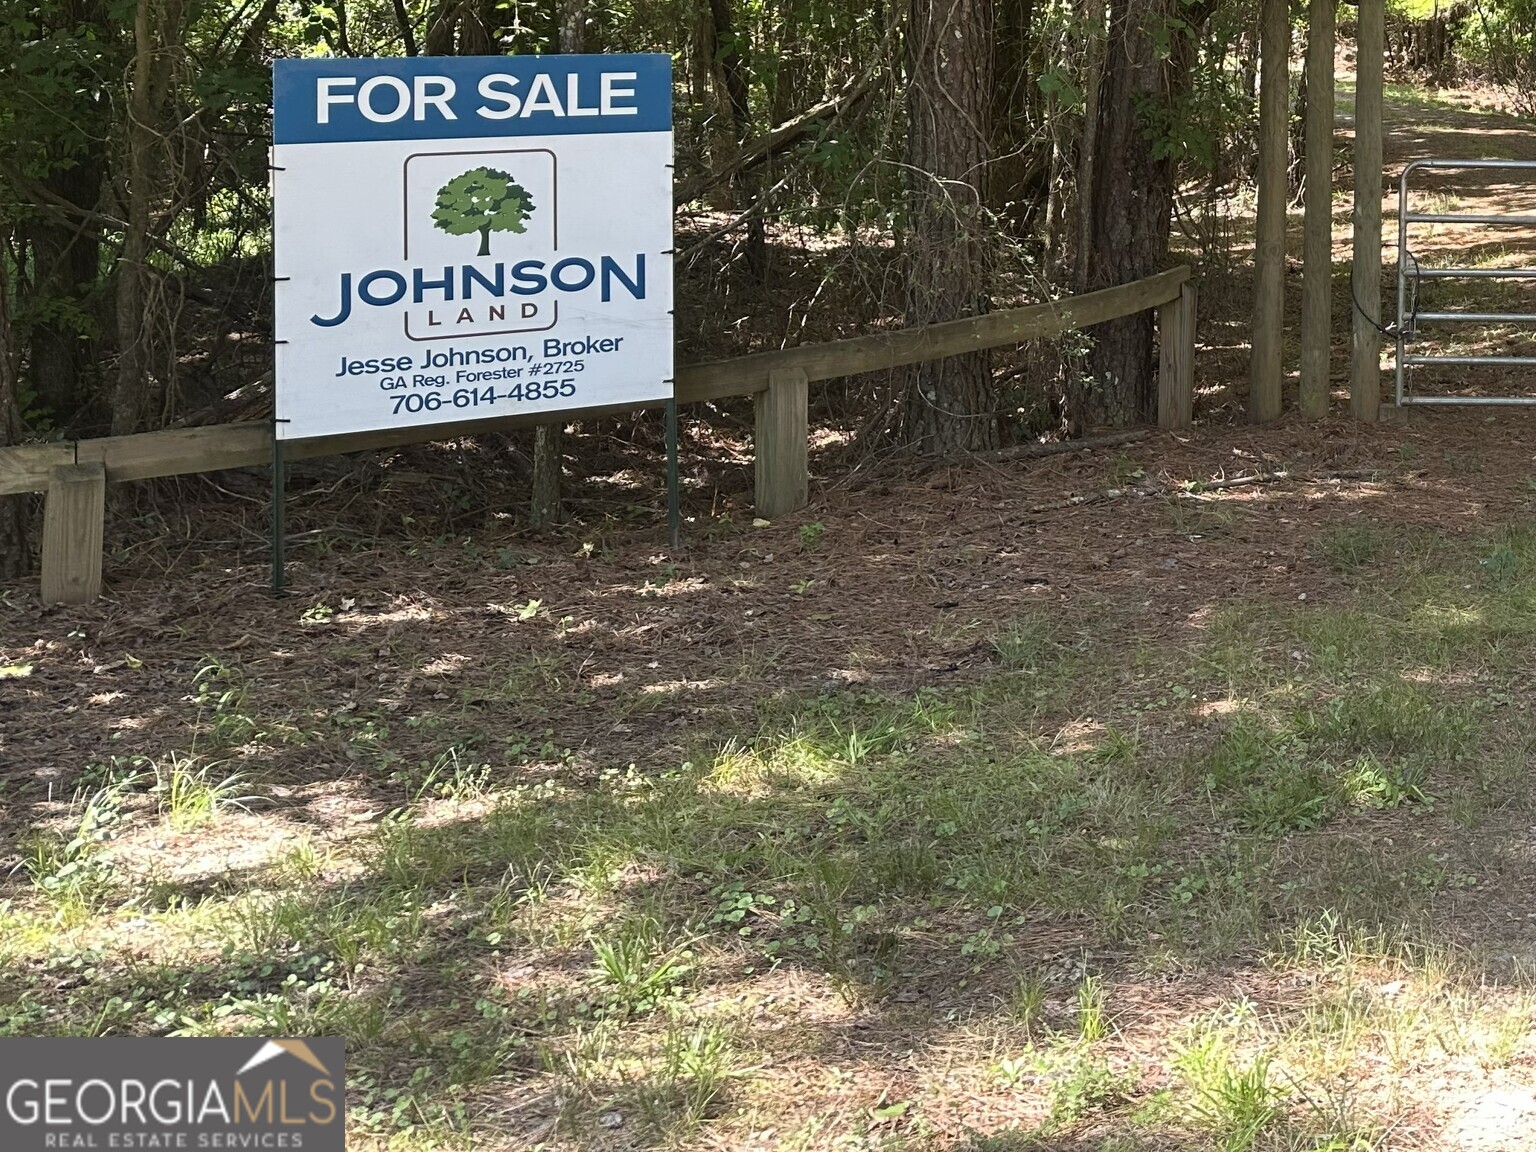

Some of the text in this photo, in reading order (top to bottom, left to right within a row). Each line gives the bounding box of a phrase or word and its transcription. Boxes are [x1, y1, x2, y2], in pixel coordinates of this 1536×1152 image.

[316, 72, 638, 124] FOR SALE
[310, 253, 646, 328] JOHNSON
[428, 303, 539, 326] LAND
[335, 336, 624, 378] Jesse Johnson, Broker
[379, 360, 585, 392] GA Reg. Forester #2725
[389, 379, 577, 415] 706-614-4855
